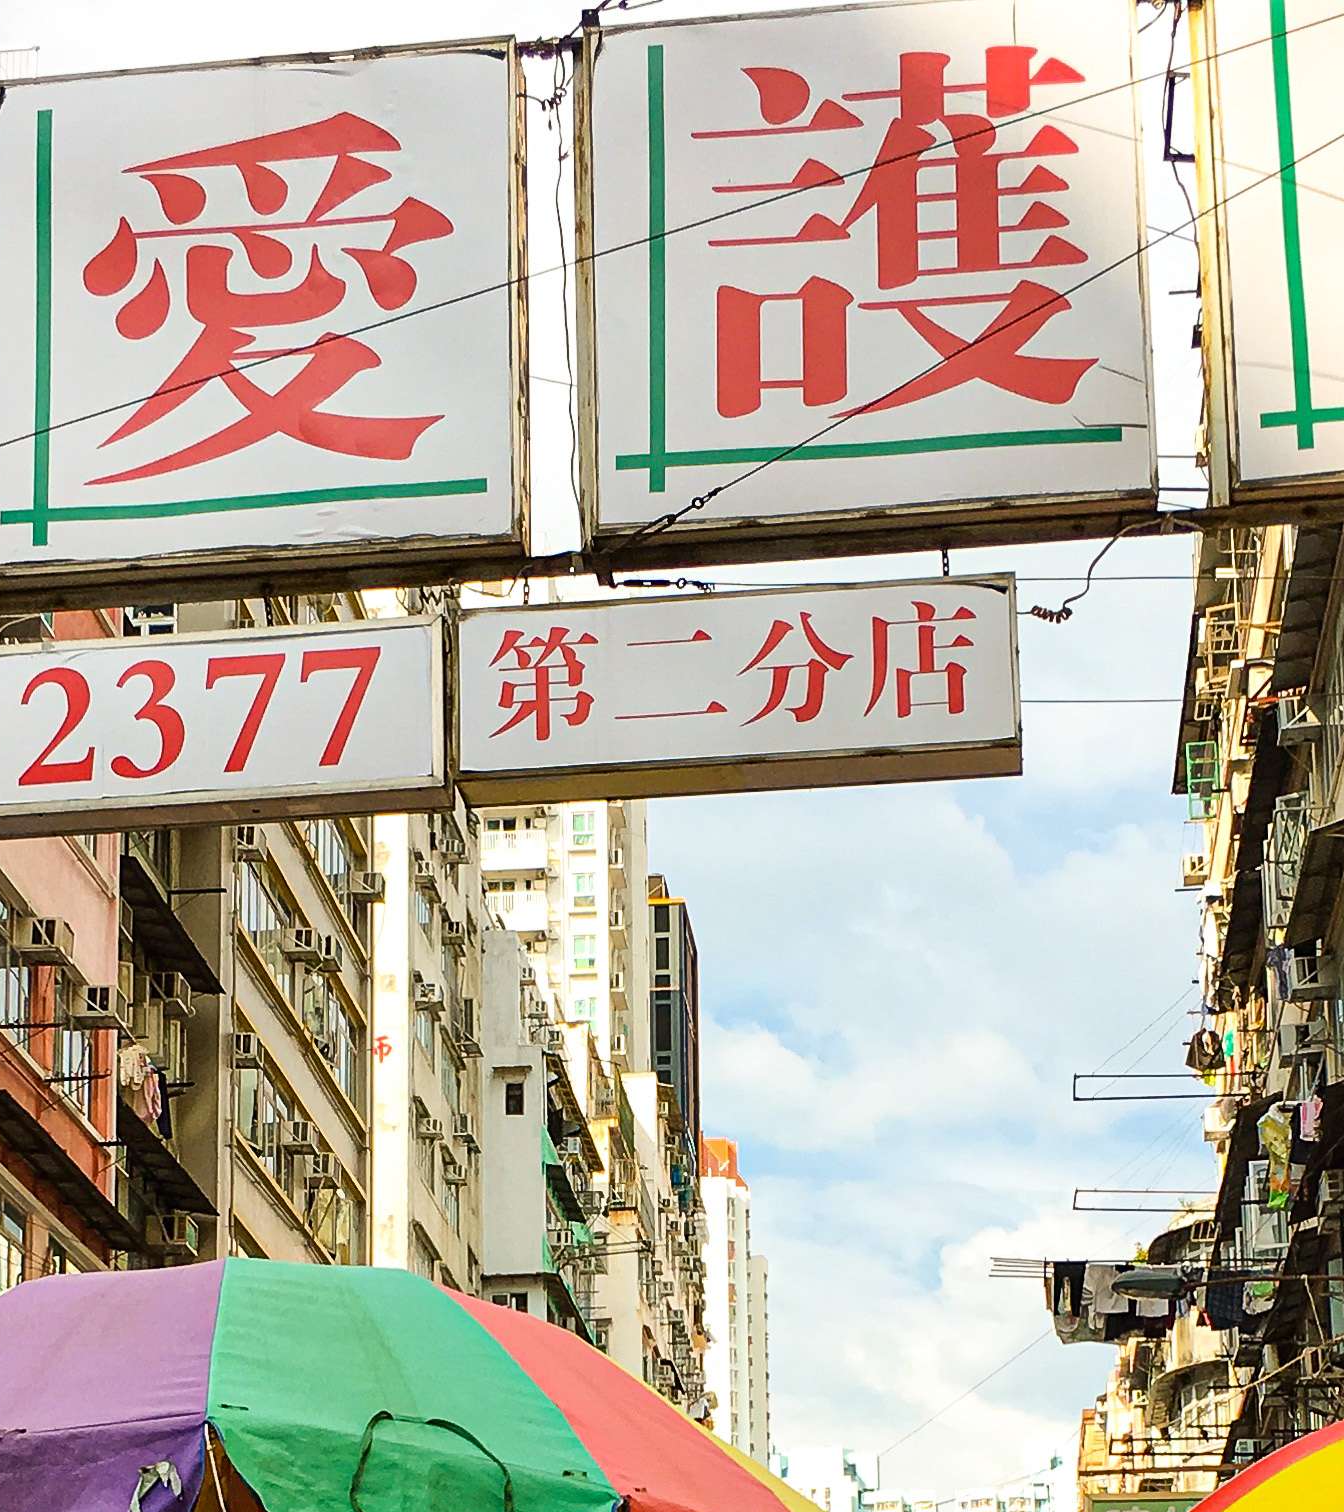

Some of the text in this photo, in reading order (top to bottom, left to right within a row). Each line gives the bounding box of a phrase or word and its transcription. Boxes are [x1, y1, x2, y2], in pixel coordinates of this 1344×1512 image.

[19, 646, 381, 786] 2377
[494, 602, 975, 741] 第二分店
